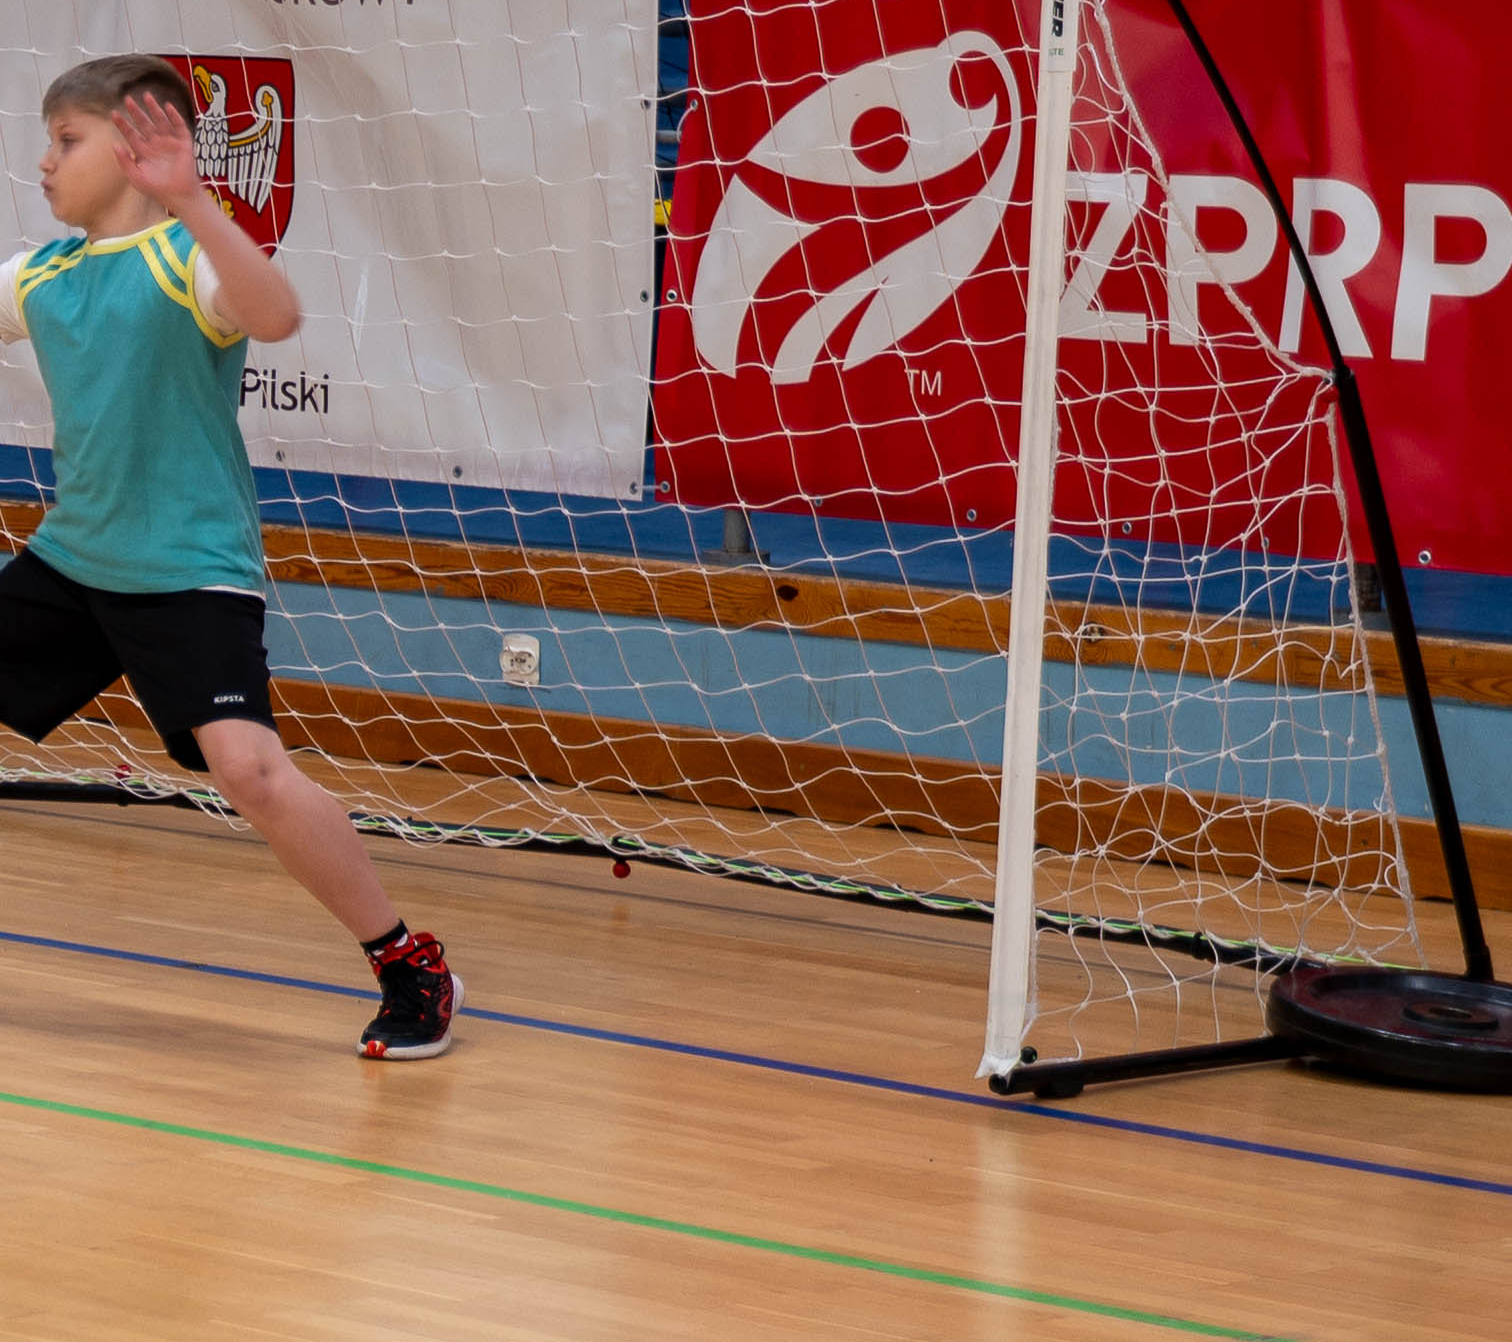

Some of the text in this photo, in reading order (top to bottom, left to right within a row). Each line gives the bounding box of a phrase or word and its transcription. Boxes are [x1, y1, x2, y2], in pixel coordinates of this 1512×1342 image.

[1057, 172, 1512, 361] ZPRP
[239, 367, 330, 414] Pilski
[904, 369, 942, 396] TM
